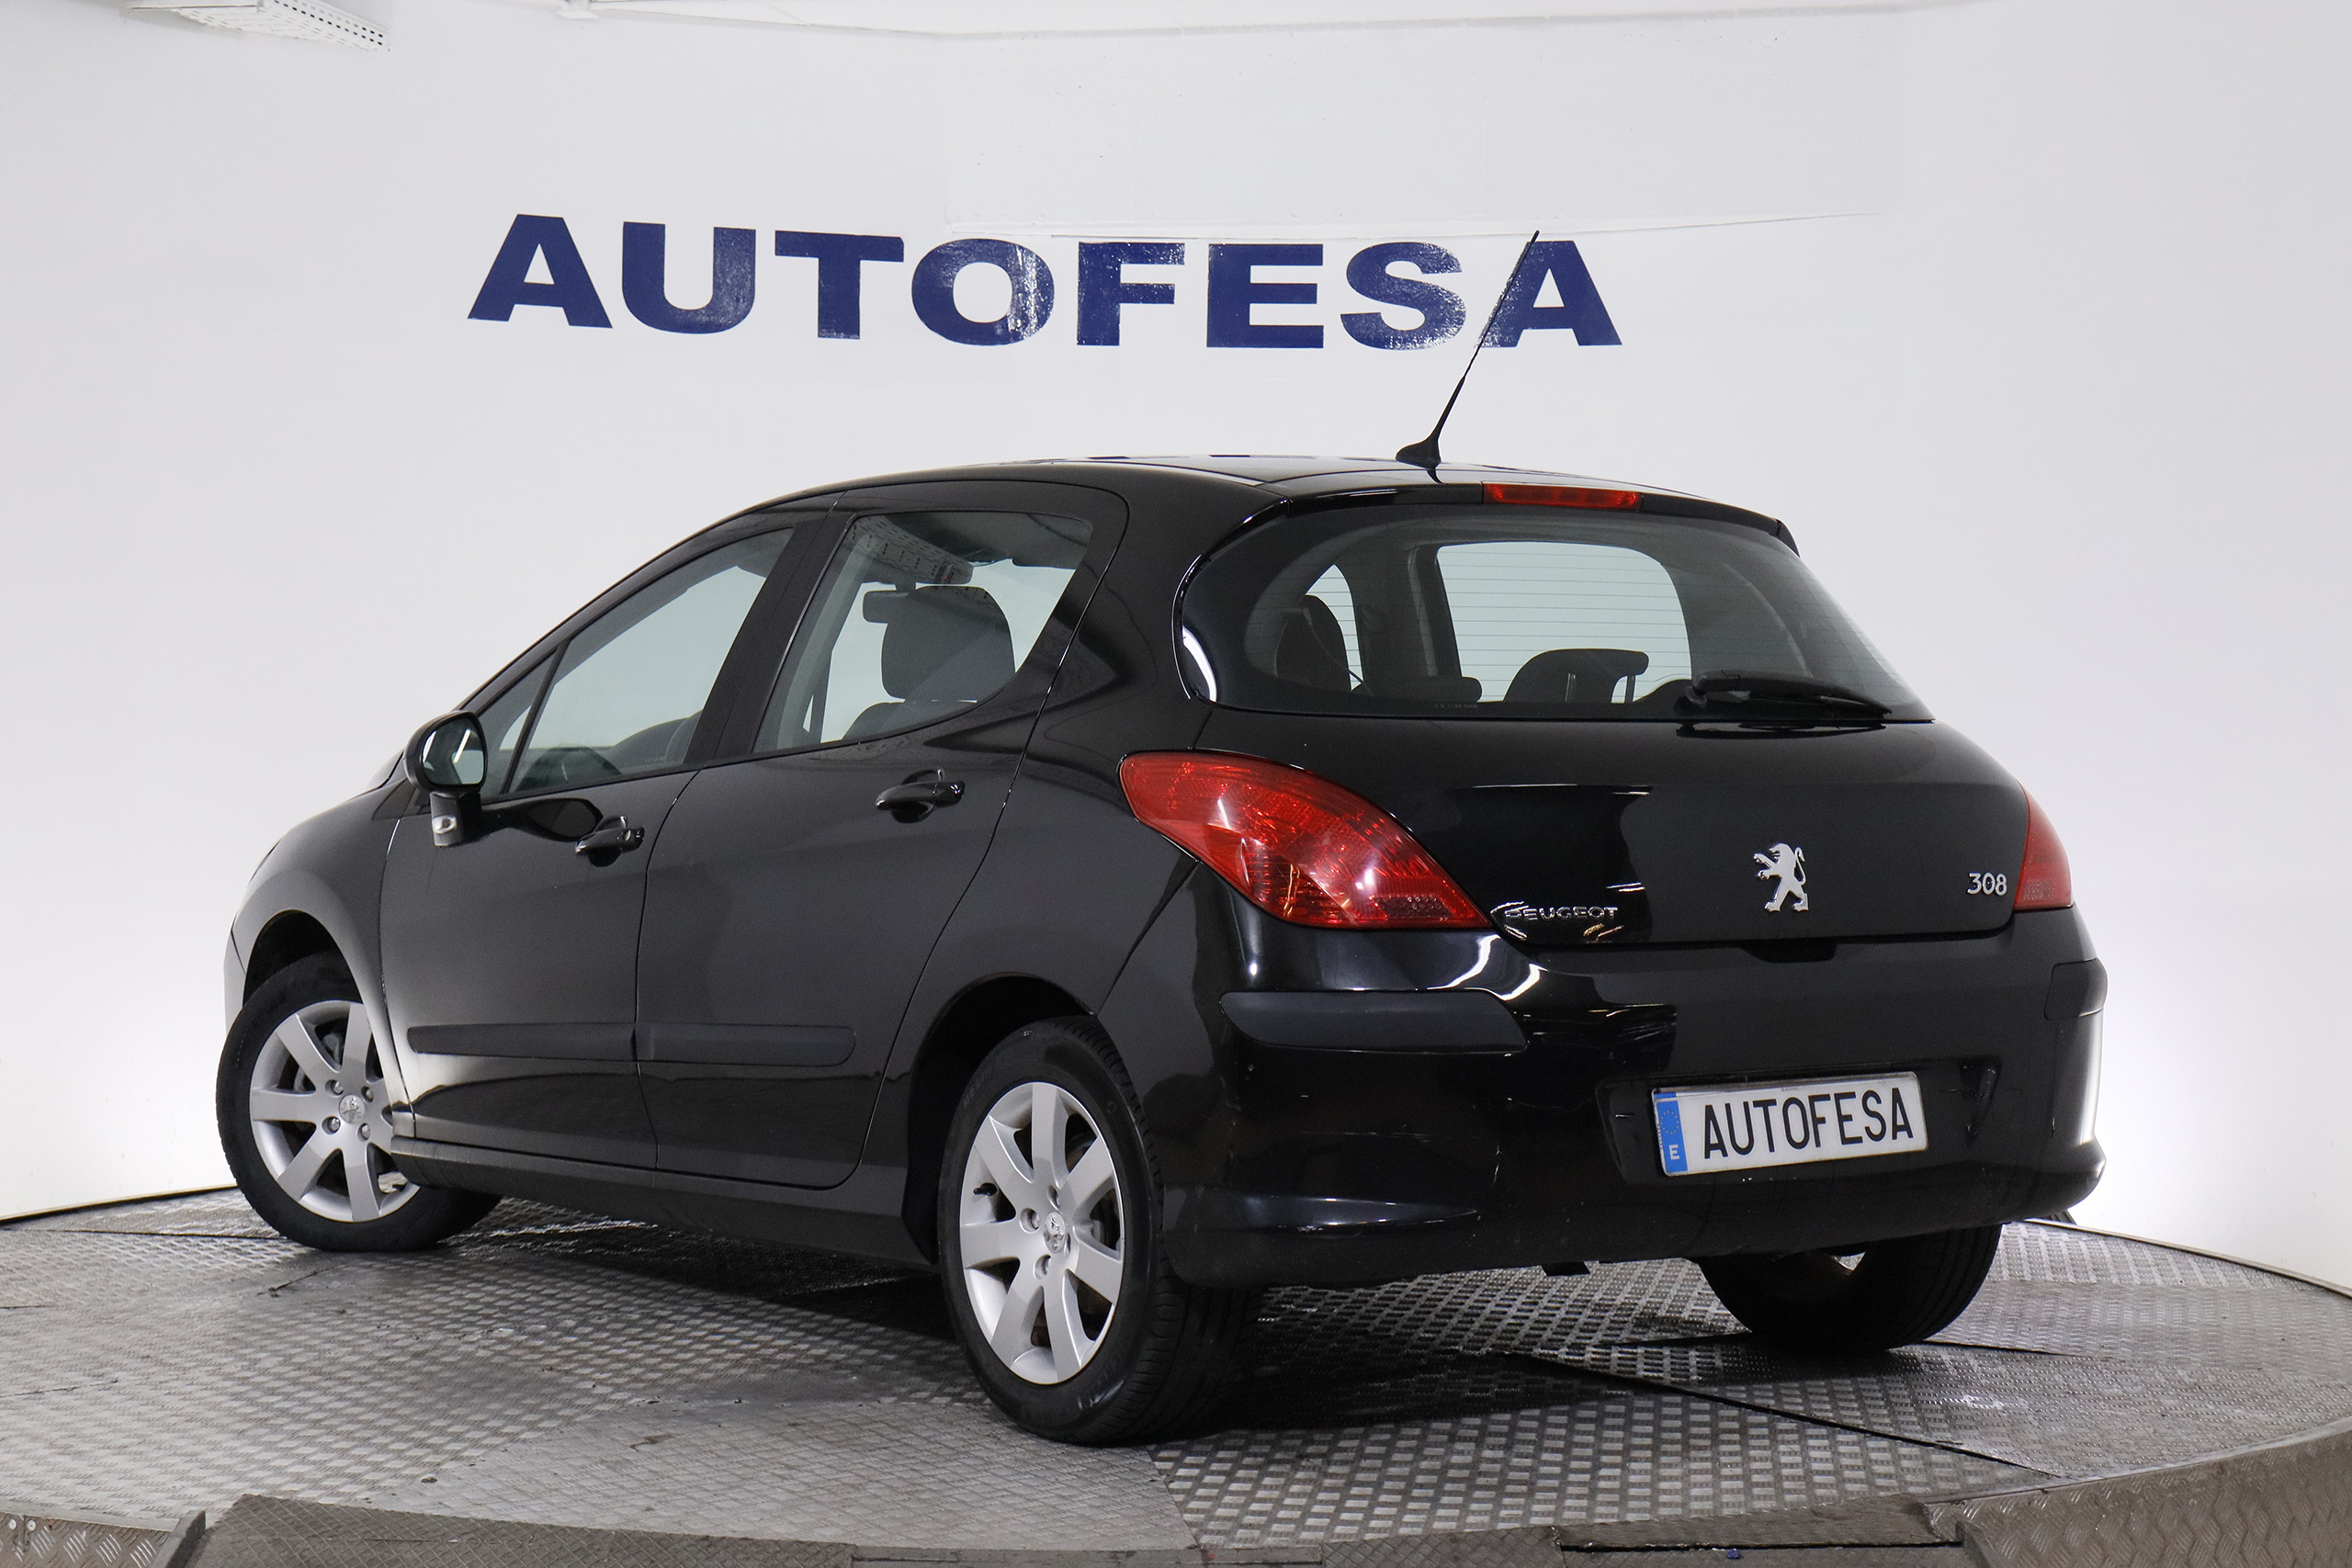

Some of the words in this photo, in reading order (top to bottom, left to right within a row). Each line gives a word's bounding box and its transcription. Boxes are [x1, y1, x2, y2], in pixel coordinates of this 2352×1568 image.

[467, 213, 1623, 350] AUTOFESA
[1967, 872, 2008, 897] 308
[1504, 905, 1619, 920] PEUGEOT
[1704, 1087, 1914, 1159] AUTOFESA
[1668, 1144, 1680, 1160] E
